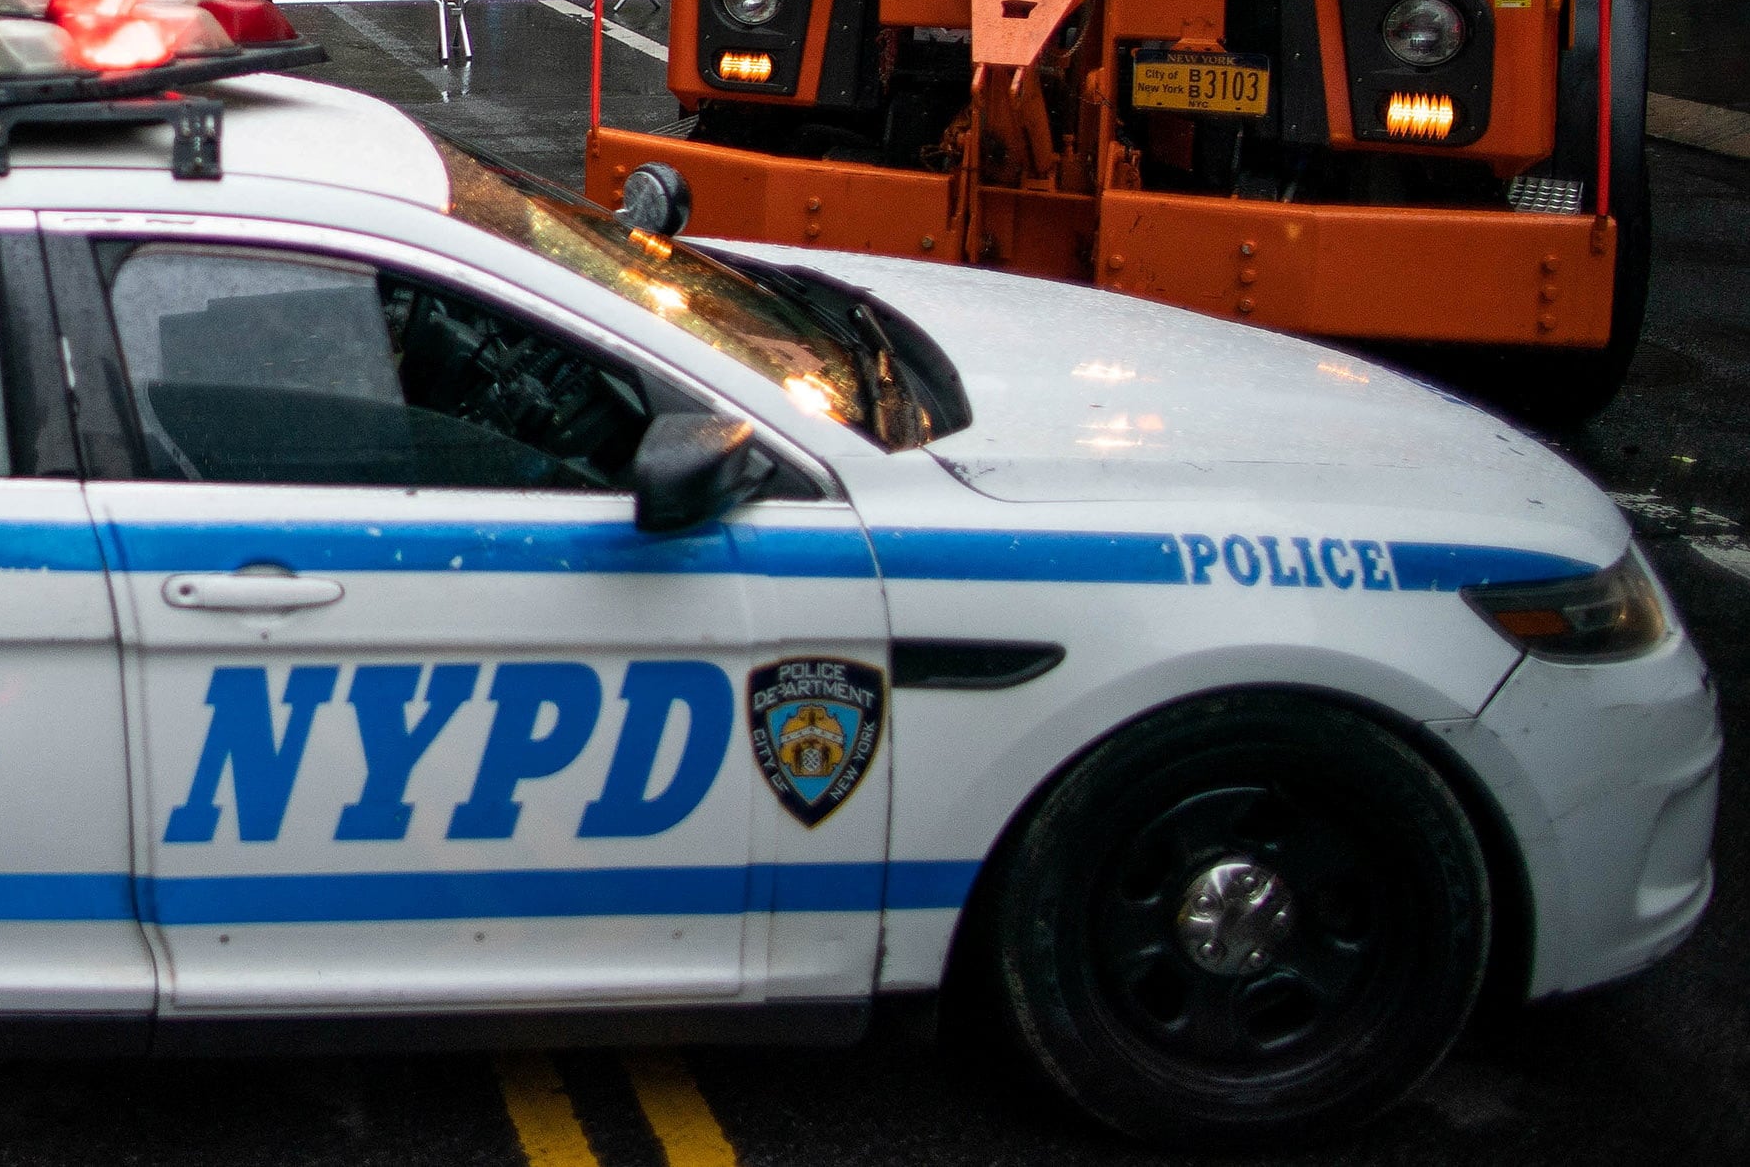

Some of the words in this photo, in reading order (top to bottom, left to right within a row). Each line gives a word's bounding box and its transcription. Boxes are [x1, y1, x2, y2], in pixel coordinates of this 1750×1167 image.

[1145, 69, 1165, 81] City
[1168, 69, 1178, 80] of
[1167, 53, 1198, 64] NEW
[1202, 55, 1237, 66] YORK
[1138, 82, 1159, 93] New
[1162, 84, 1184, 94] York
[1204, 70, 1259, 102] 3103
[1188, 100, 1209, 108] NYC
[1179, 532, 1394, 591] POLICE
[778, 662, 847, 681] POLICE
[753, 680, 876, 711] DEPARTMENT
[162, 660, 736, 844] NYPD
[753, 728, 779, 773] CITY
[829, 765, 862, 801] NEW
[852, 720, 876, 763] YORK
